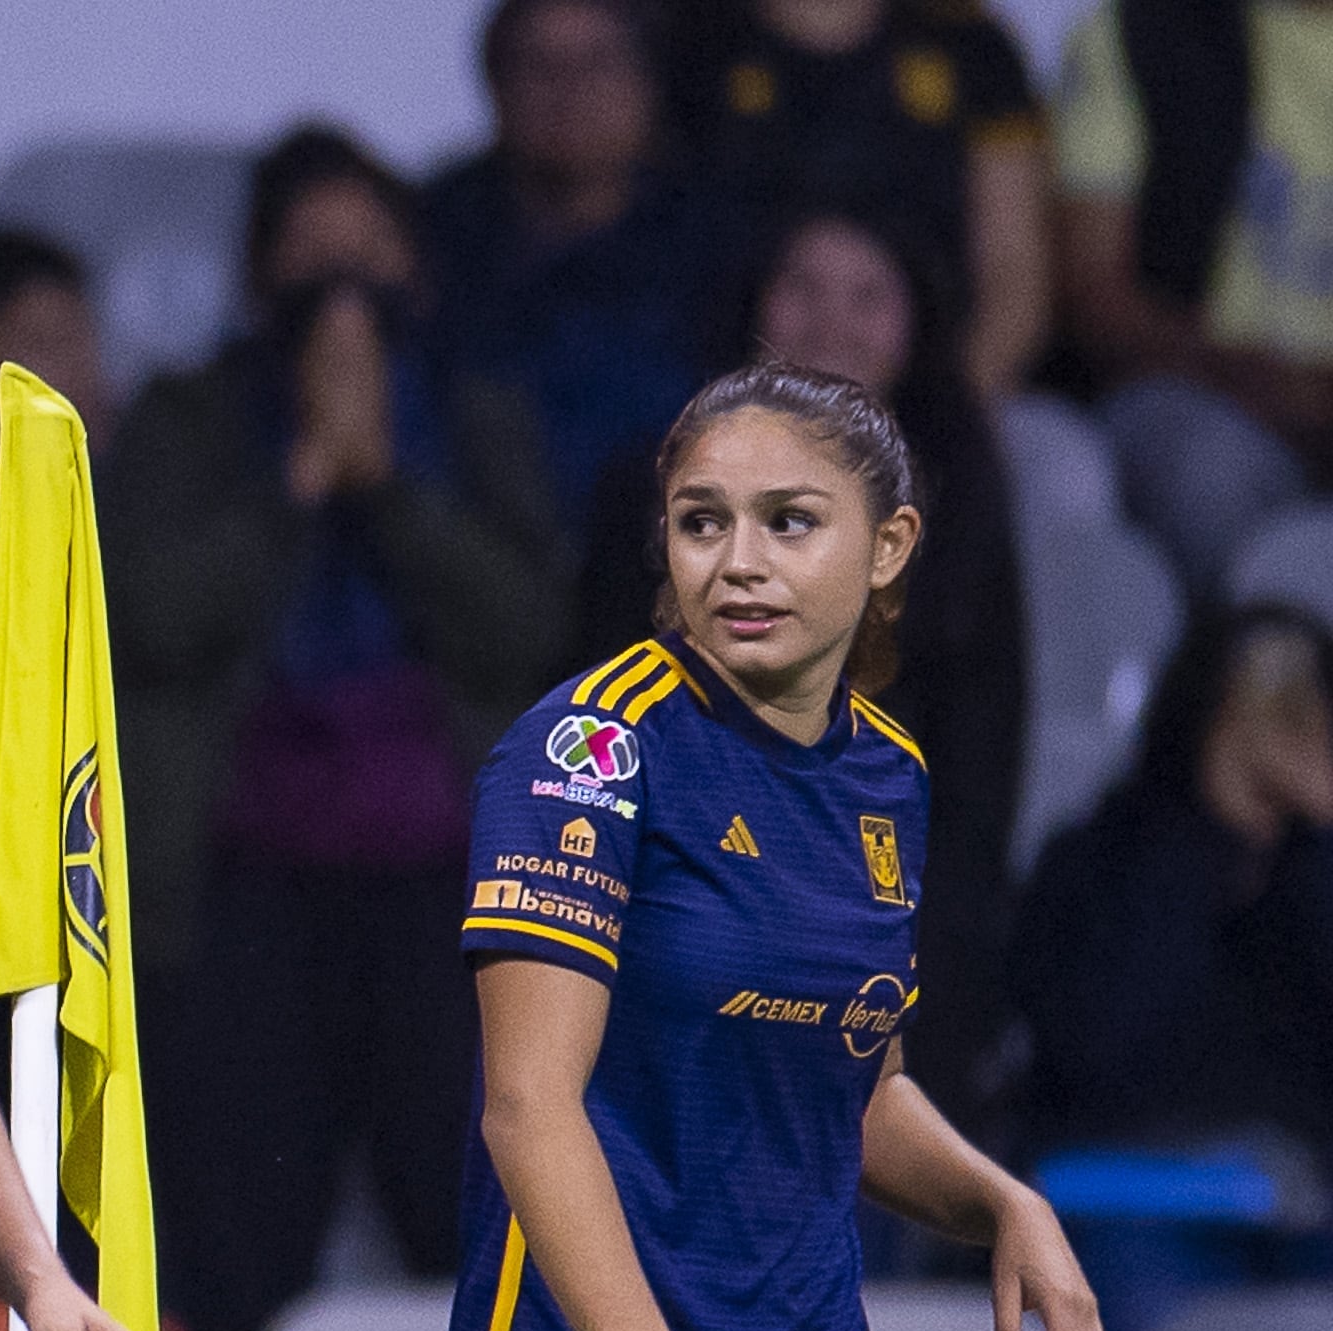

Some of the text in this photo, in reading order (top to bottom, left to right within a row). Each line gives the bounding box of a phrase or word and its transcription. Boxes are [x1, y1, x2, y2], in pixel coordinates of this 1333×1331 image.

[563, 833, 593, 852] HF
[496, 854, 569, 879] HOGAR
[751, 998, 829, 1026] CEMEX
